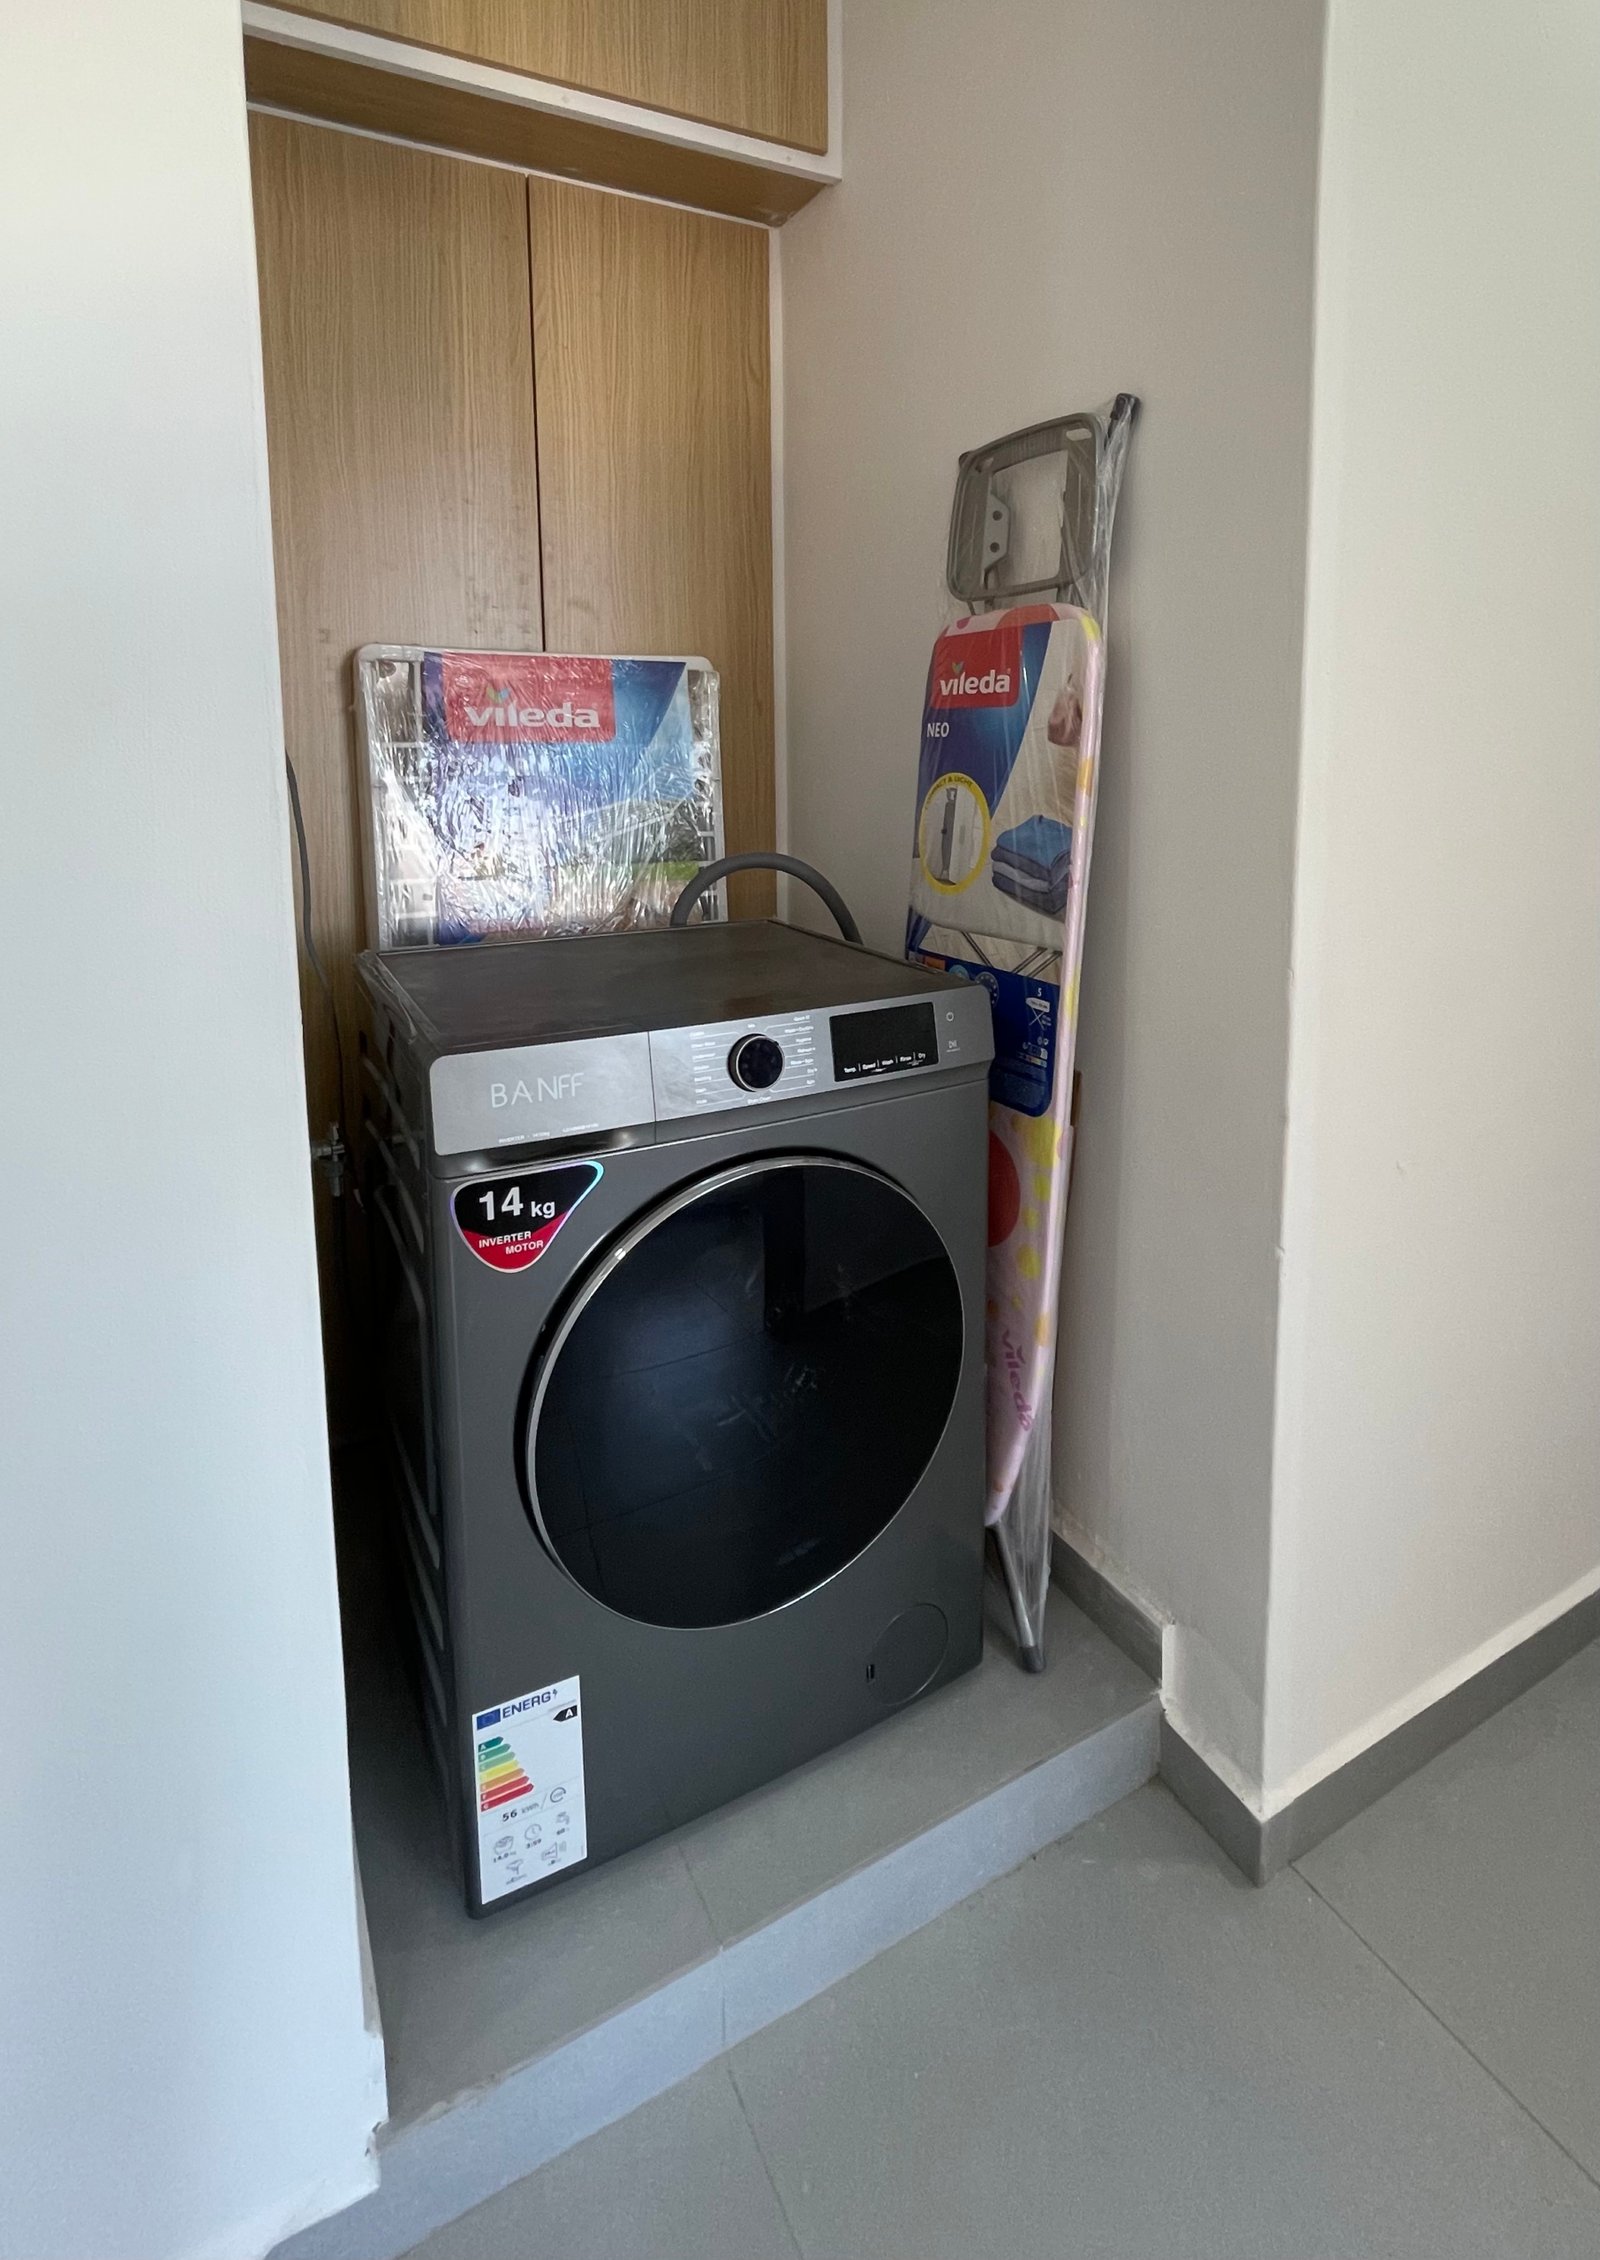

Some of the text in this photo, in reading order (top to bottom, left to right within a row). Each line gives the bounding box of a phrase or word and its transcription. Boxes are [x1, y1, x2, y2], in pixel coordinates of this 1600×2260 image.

[940, 668, 1011, 696] vileda
[465, 697, 601, 728] vileda
[927, 721, 950, 738] NEO
[490, 1072, 585, 1109] BANFF
[479, 1186, 556, 1221] 14 kg
[479, 1230, 532, 1249] INVERTER
[505, 1239, 544, 1255] MOTOR
[502, 1691, 551, 1719] ENERG
[565, 1708, 573, 1719] A
[502, 1808, 518, 1822] 56
